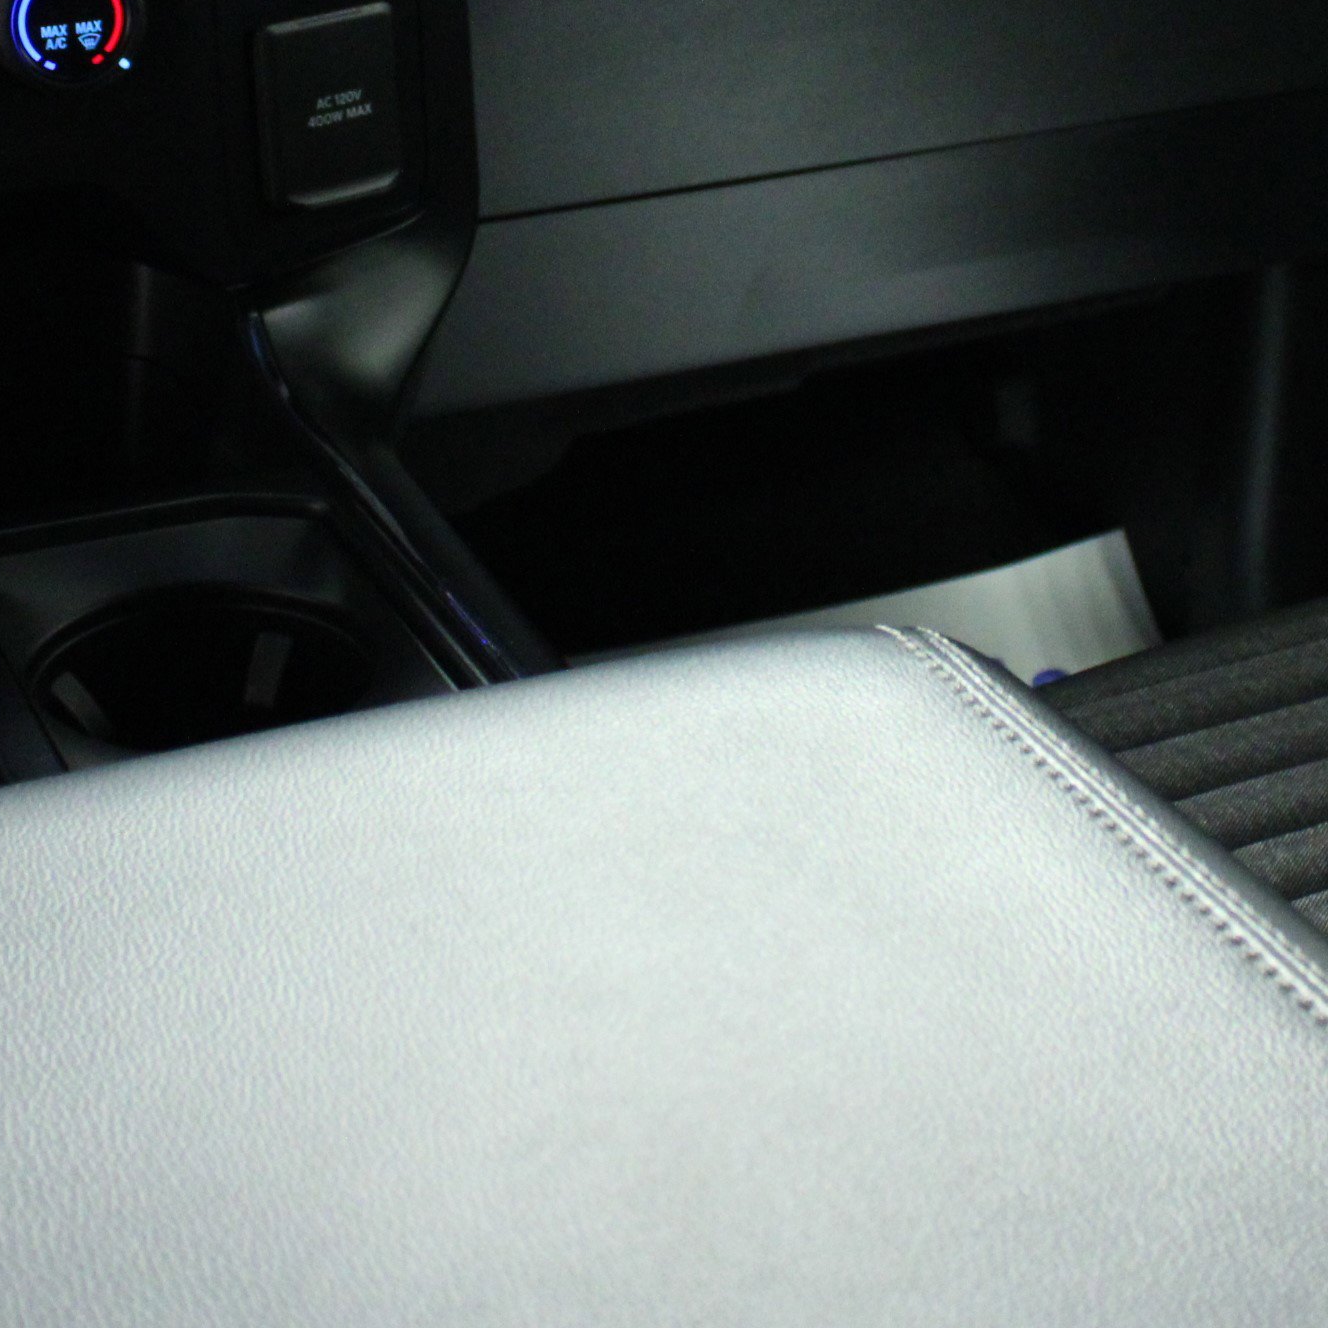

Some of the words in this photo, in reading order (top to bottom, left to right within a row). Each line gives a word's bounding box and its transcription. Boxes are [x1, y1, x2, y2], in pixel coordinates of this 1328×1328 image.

[40, 24, 69, 38] MAX
[75, 20, 103, 34] MAX
[45, 37, 68, 50] A/C
[317, 96, 332, 110] AC
[346, 103, 372, 118] MAX
